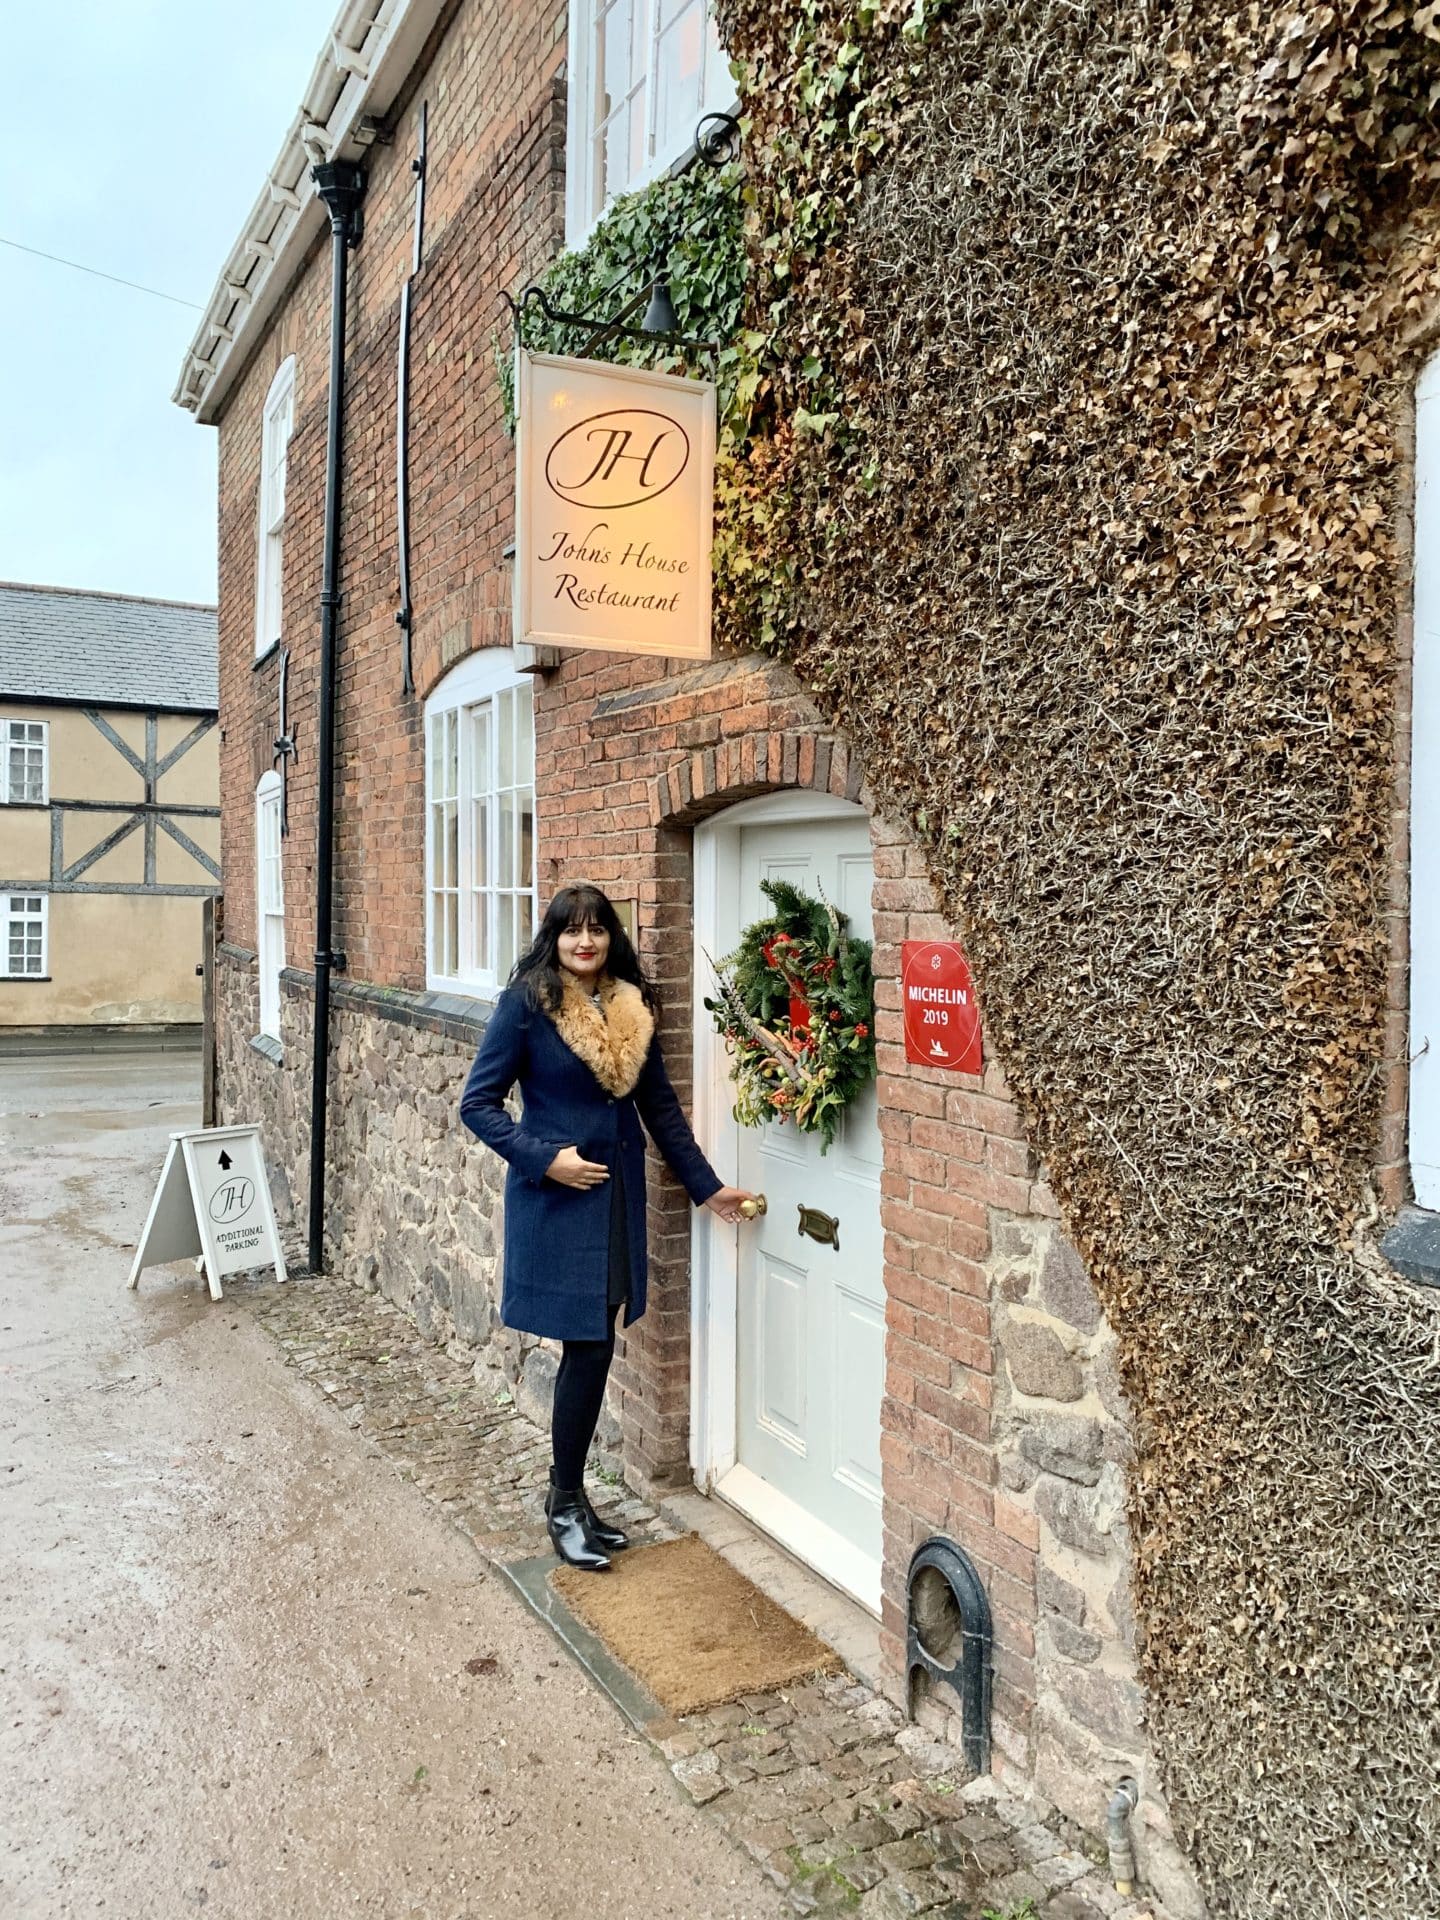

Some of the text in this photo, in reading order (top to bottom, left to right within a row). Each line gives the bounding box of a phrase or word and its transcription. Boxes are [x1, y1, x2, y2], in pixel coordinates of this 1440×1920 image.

[538, 523, 690, 574] John's House
[554, 573, 680, 613] Restaurant
[908, 986, 967, 1005] MICHELIN
[922, 1009, 949, 1025] 2019
[215, 1225, 264, 1243] ADDITIONAL
[224, 1238, 259, 1252] PARKING
